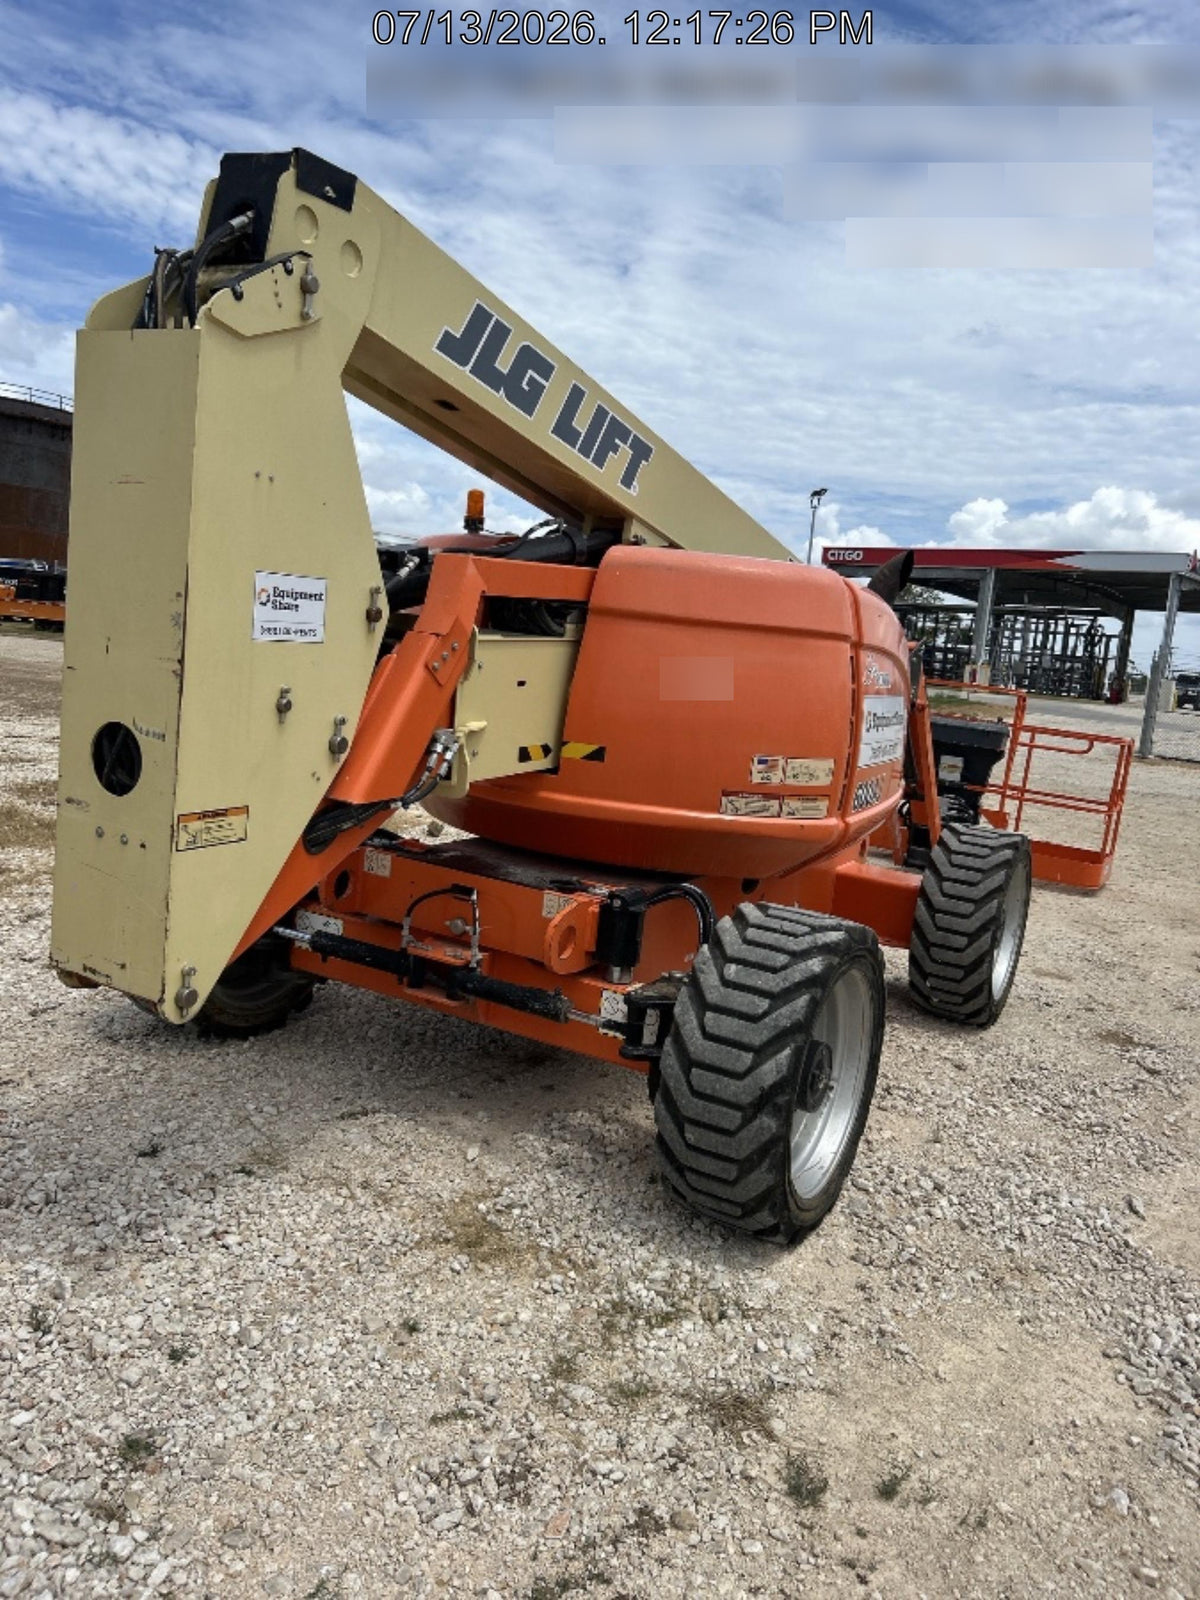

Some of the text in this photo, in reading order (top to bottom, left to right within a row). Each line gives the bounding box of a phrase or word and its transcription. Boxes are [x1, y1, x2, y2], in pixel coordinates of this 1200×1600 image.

[432, 299, 655, 496] JLG LIFT
[827, 550, 864, 561] CITGO
[272, 586, 325, 602] Equipment
[271, 599, 300, 612] Share
